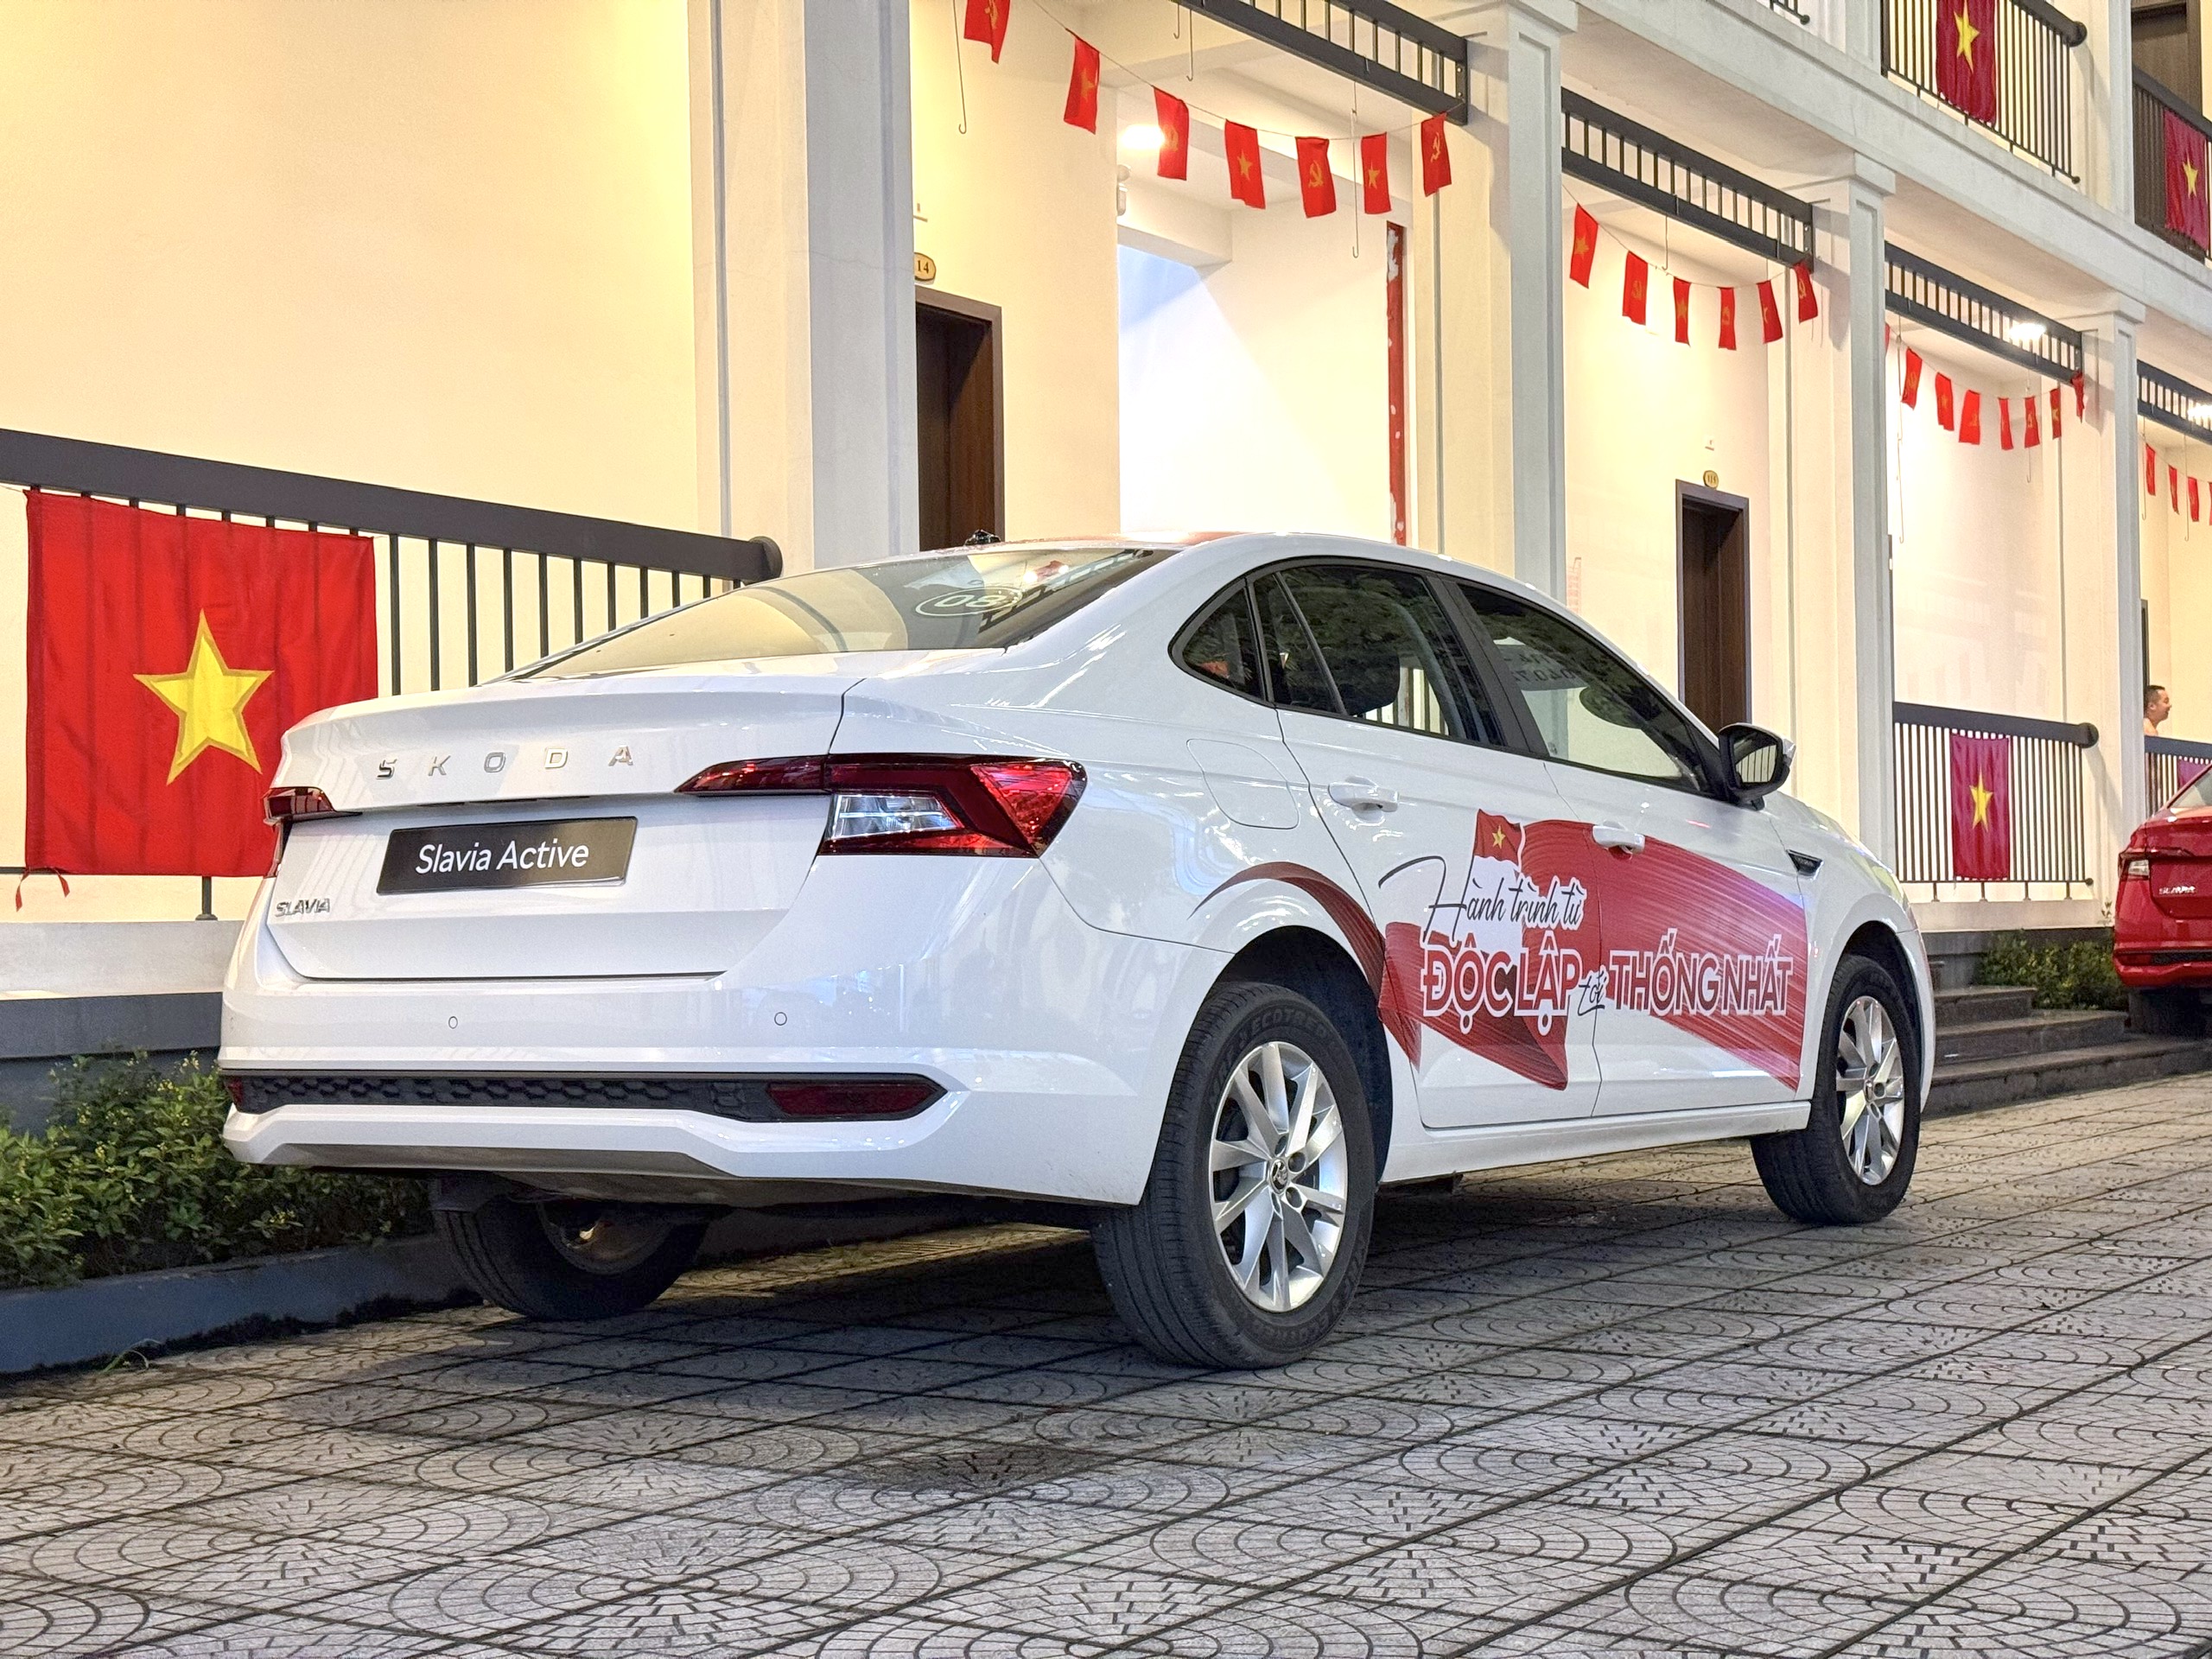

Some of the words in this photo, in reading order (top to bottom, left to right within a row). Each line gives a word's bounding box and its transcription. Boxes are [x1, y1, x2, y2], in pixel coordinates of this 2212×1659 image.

[375, 744, 634, 780] SKODA
[415, 842, 493, 874] Slavia
[496, 838, 589, 870] Active
[274, 898, 331, 918] SLAVIA
[1377, 855, 1506, 944] Hành
[1508, 876, 1560, 924] trình
[1421, 932, 1513, 1034] ĐỘC
[1515, 931, 1583, 1035] LẬP
[1609, 927, 1721, 1016] THỐNG
[1721, 933, 1794, 1015] NHẤT
